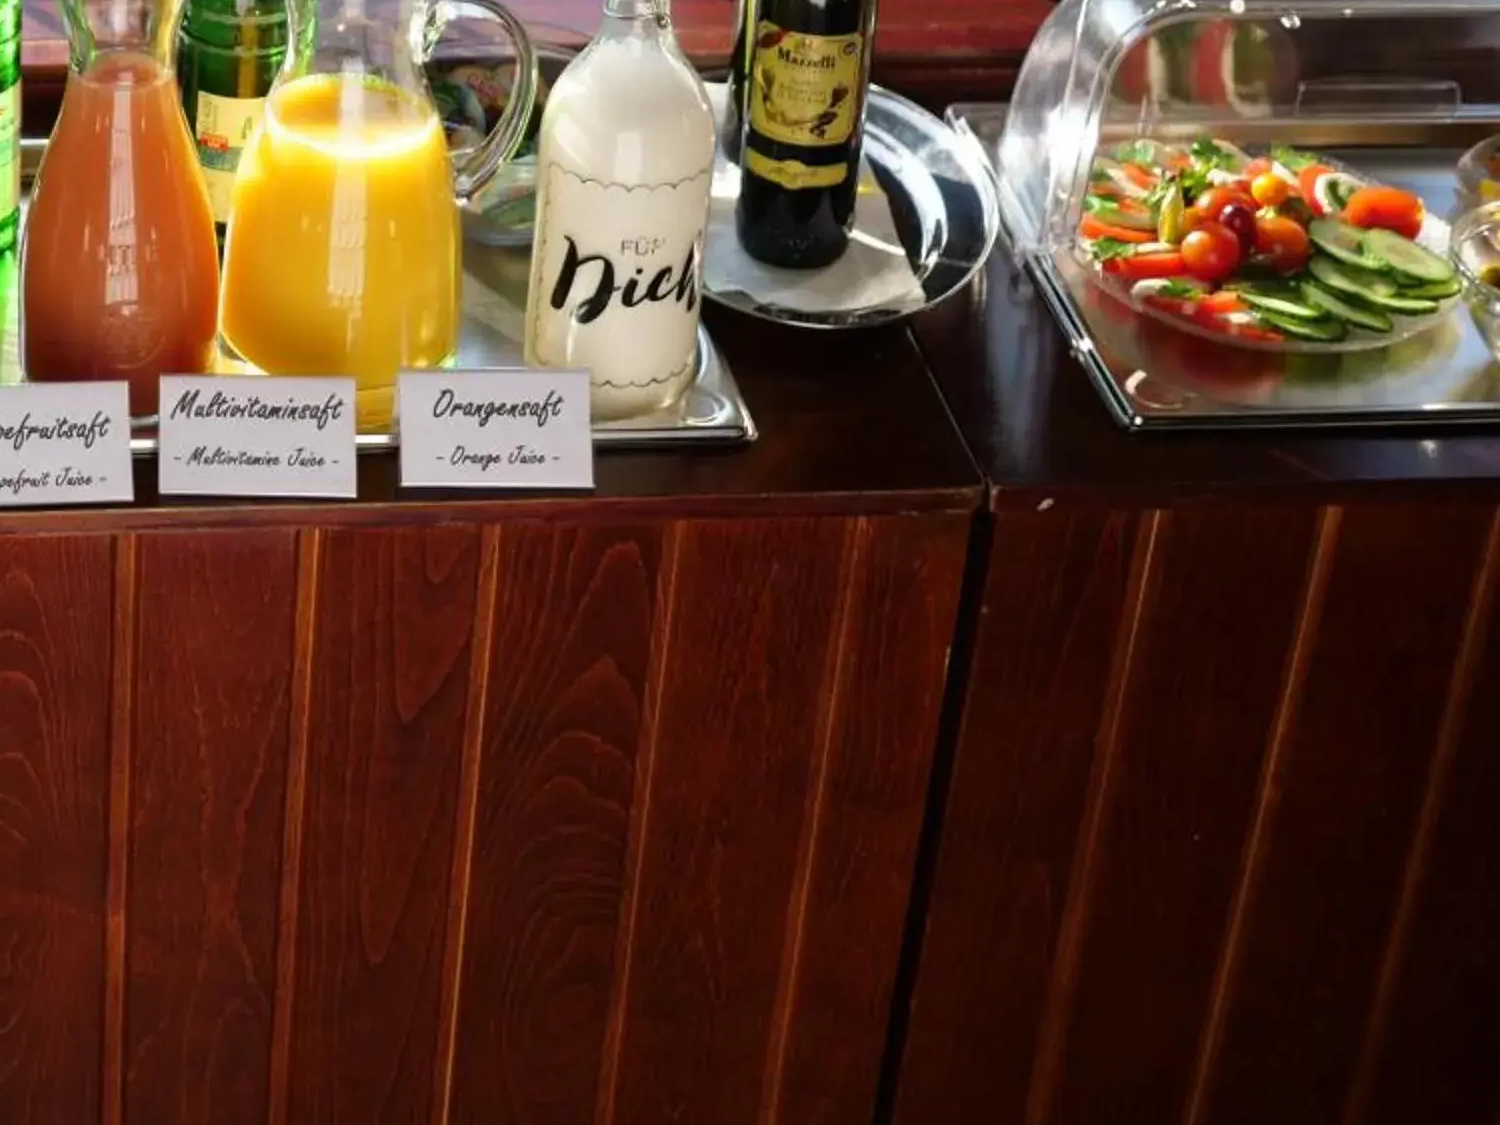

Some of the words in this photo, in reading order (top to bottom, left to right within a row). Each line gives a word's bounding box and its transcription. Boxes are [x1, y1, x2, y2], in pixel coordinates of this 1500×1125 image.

[550, 230, 702, 324] Dich
[170, 389, 345, 431] Multivitaminsaft
[433, 389, 565, 428] Orangensaft
[287, 447, 326, 468] Juice
[450, 445, 502, 472] Orange
[507, 445, 546, 465] Juice
[55, 466, 94, 488] Juice
